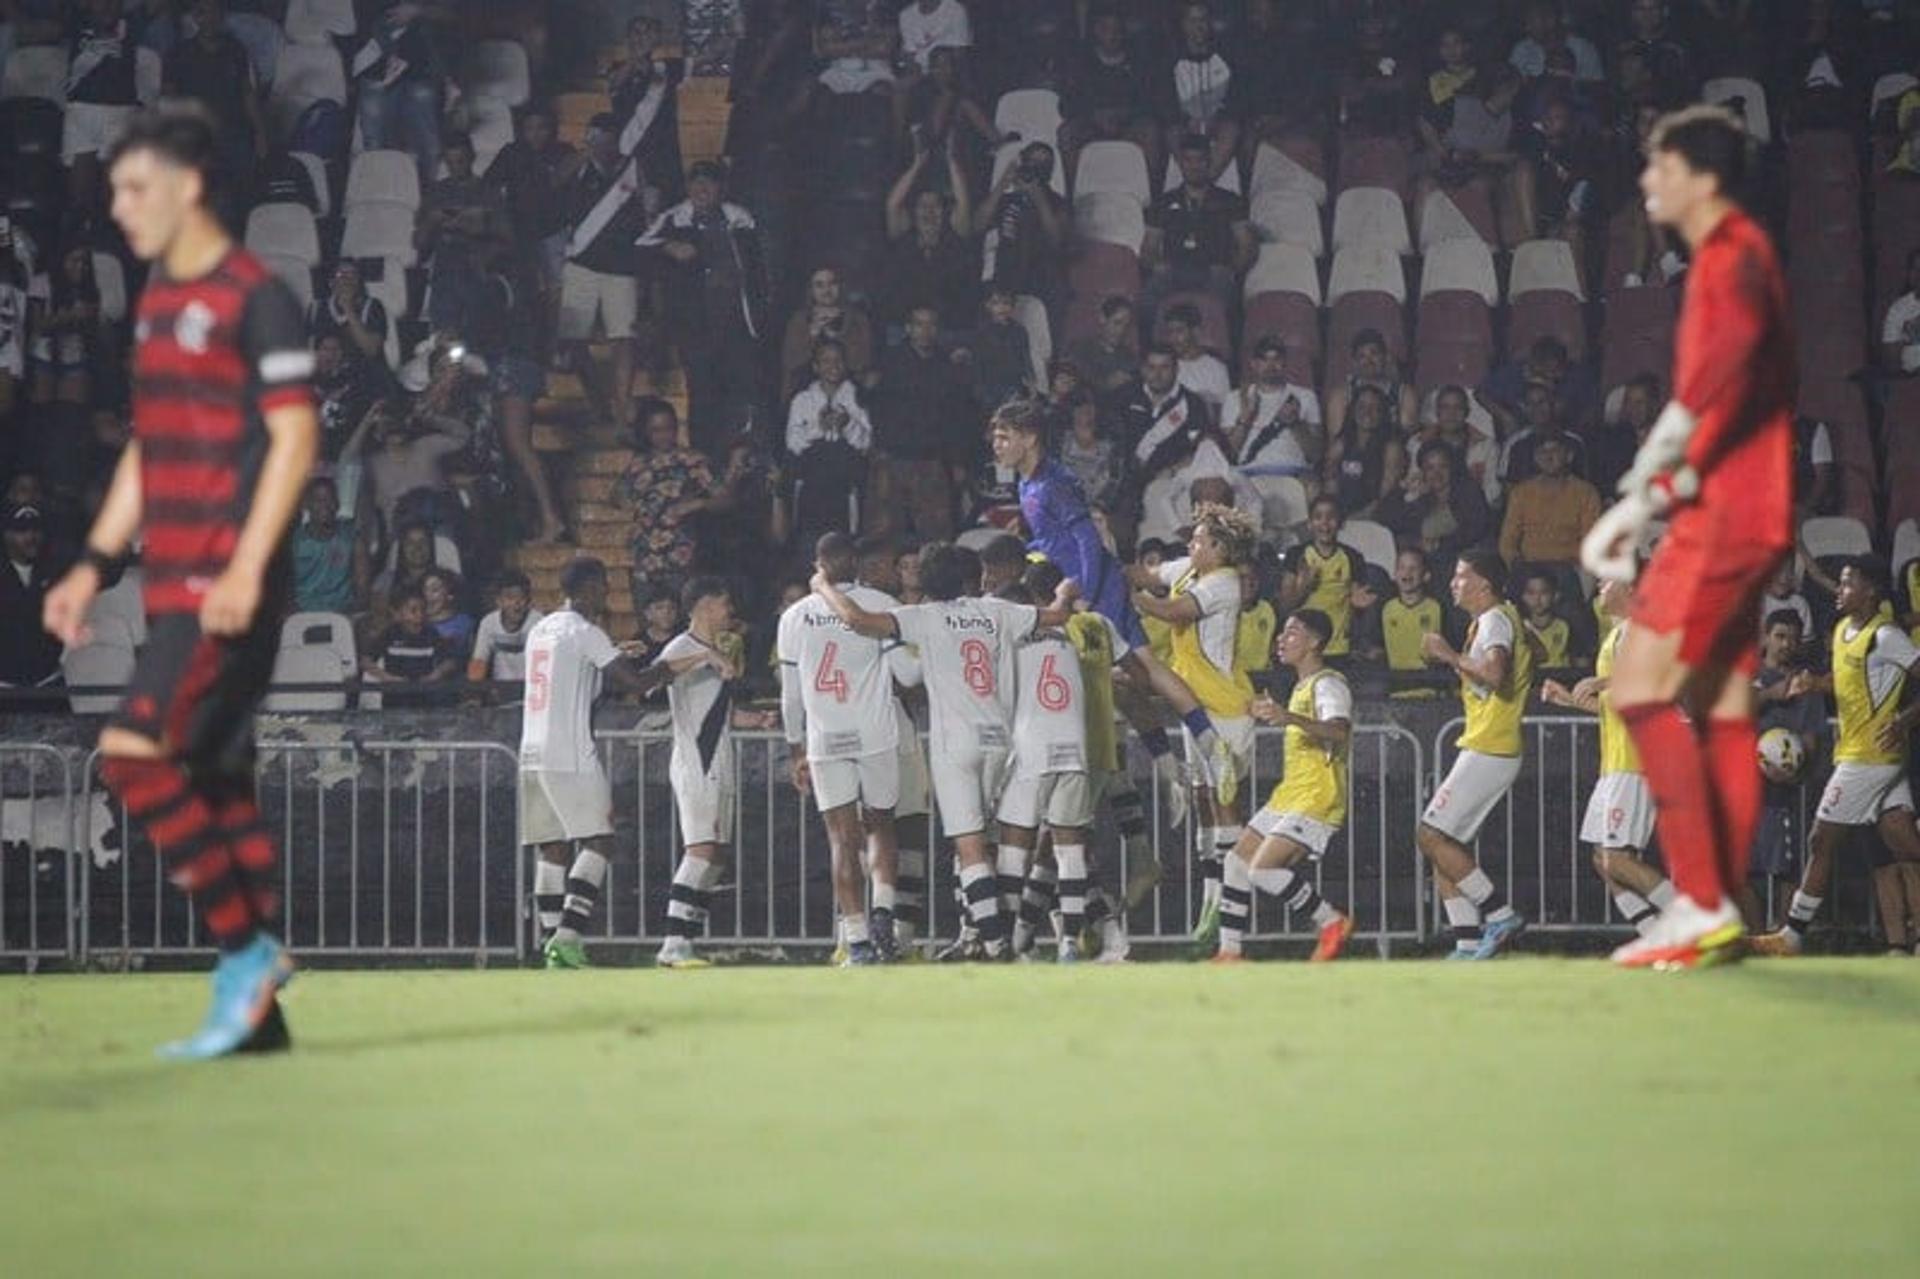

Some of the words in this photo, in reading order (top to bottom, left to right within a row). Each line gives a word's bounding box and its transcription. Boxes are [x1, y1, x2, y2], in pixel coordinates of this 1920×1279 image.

[527, 649, 550, 713] 5
[815, 641, 847, 702] 4
[960, 638, 994, 698] 8
[1037, 654, 1071, 712] 6
